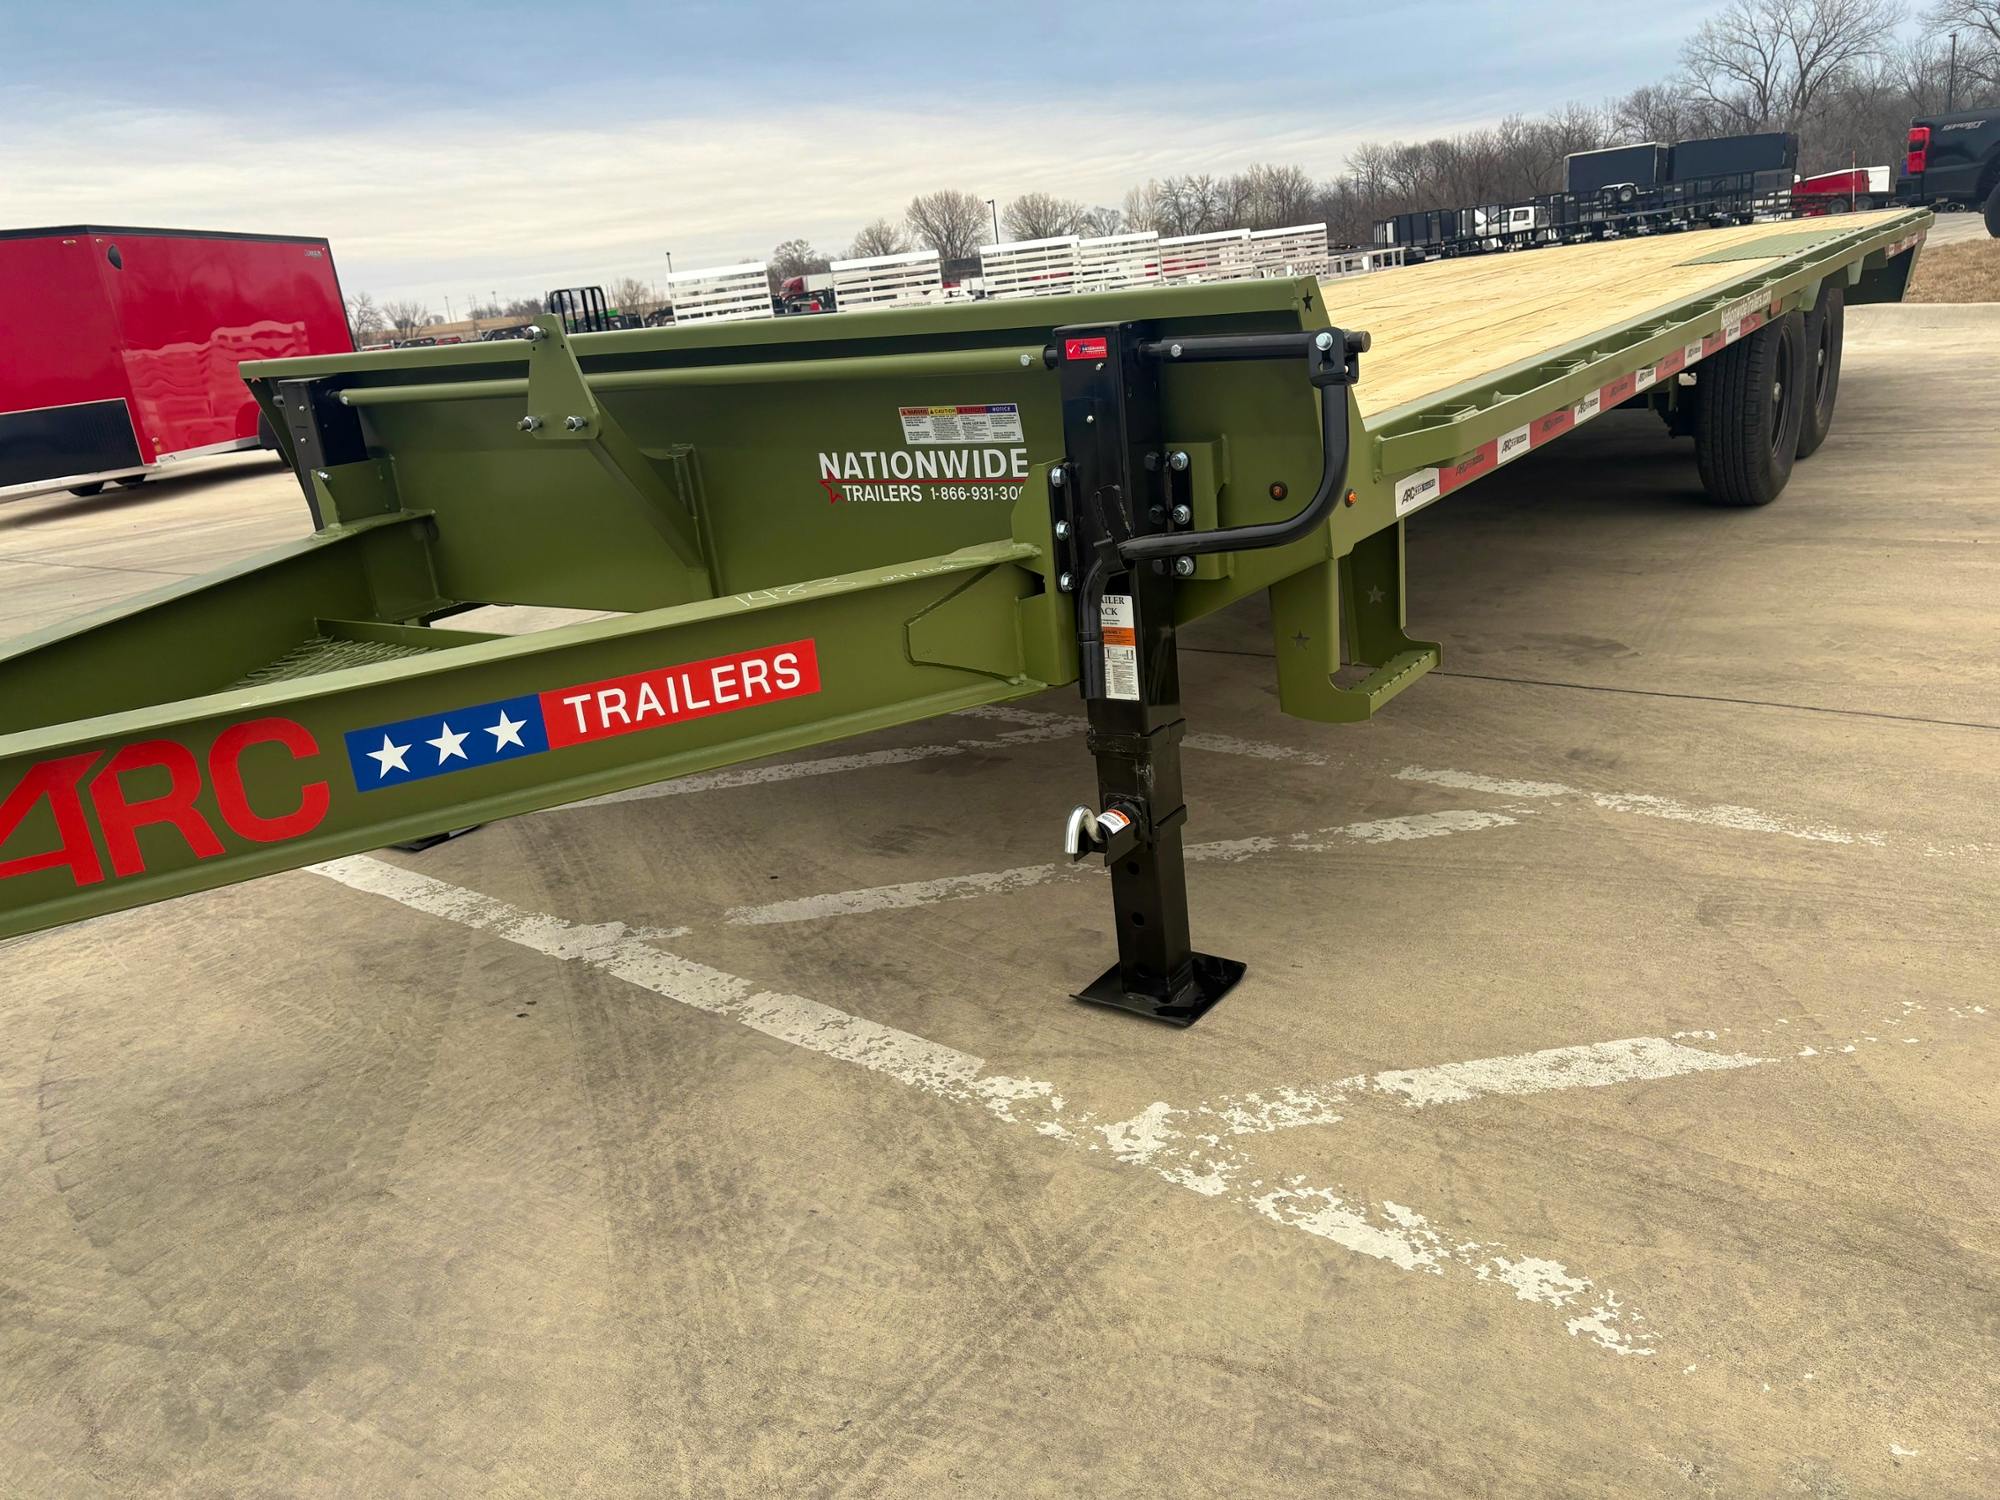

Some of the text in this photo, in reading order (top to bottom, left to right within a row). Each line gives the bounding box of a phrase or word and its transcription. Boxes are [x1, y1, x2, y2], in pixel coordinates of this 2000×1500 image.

[818, 448, 1029, 480] NATIONWIDE
[842, 485, 923, 502] TRAILERS
[1401, 486, 1415, 505] ARC
[0, 652, 801, 887] ARC TRAILERS
